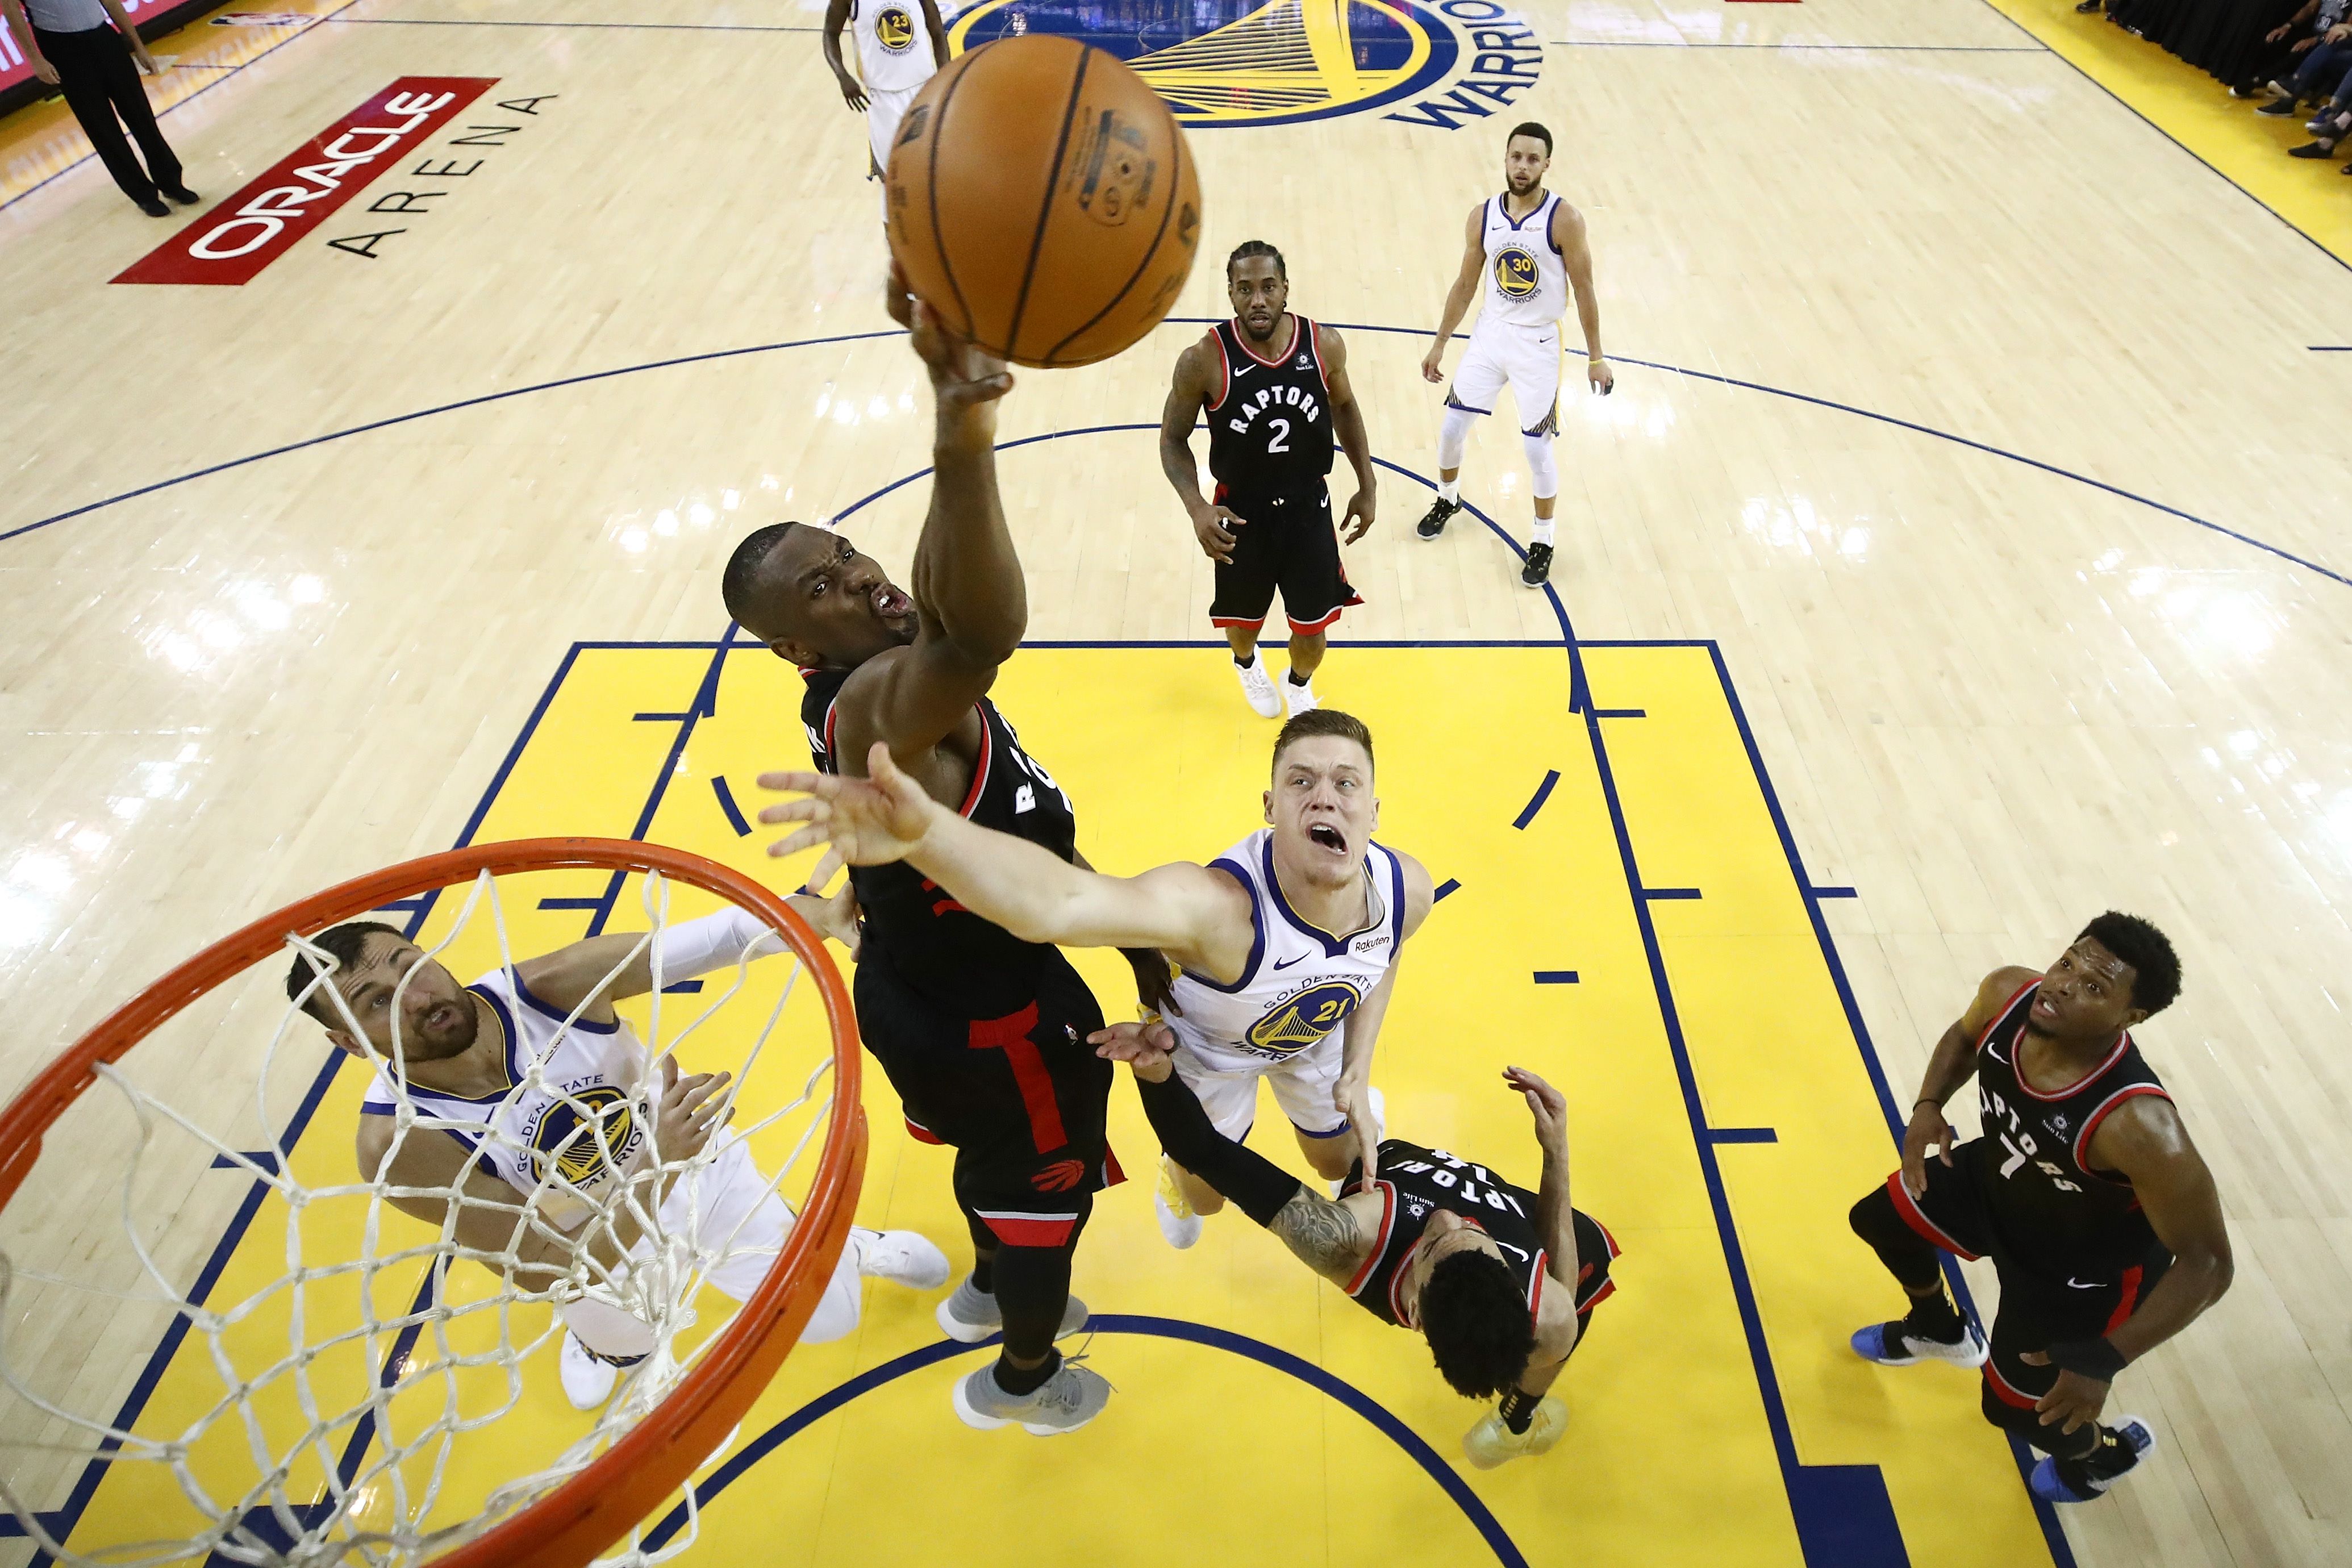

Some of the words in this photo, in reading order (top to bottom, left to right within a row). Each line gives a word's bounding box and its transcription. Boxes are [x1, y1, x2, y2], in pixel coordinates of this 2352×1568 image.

[892, 15, 908, 27] 23
[880, 40, 918, 56] WARRIORS
[1379, 0, 1543, 130] WARRIO
[189, 90, 456, 259] ORACLE
[326, 94, 558, 258] ARENA
[1492, 241, 1517, 257] GOLDEN
[1520, 243, 1539, 258] STATE
[1512, 258, 1531, 272] 30
[1496, 287, 1542, 304] WARRIORS
[1229, 385, 1319, 433] RAPTORS
[1267, 419, 1290, 453] 2
[1356, 936, 1390, 952] Rakuten
[1264, 974, 1336, 1008] GOLDEN
[1311, 998, 1350, 1023] 21
[548, 1074, 604, 1099] TATE
[1980, 1085, 2083, 1192] APTORS
[2000, 1132, 2026, 1180] 7
[1403, 1192, 1418, 1202] Life
[1419, 1198, 1435, 1207] Sun
